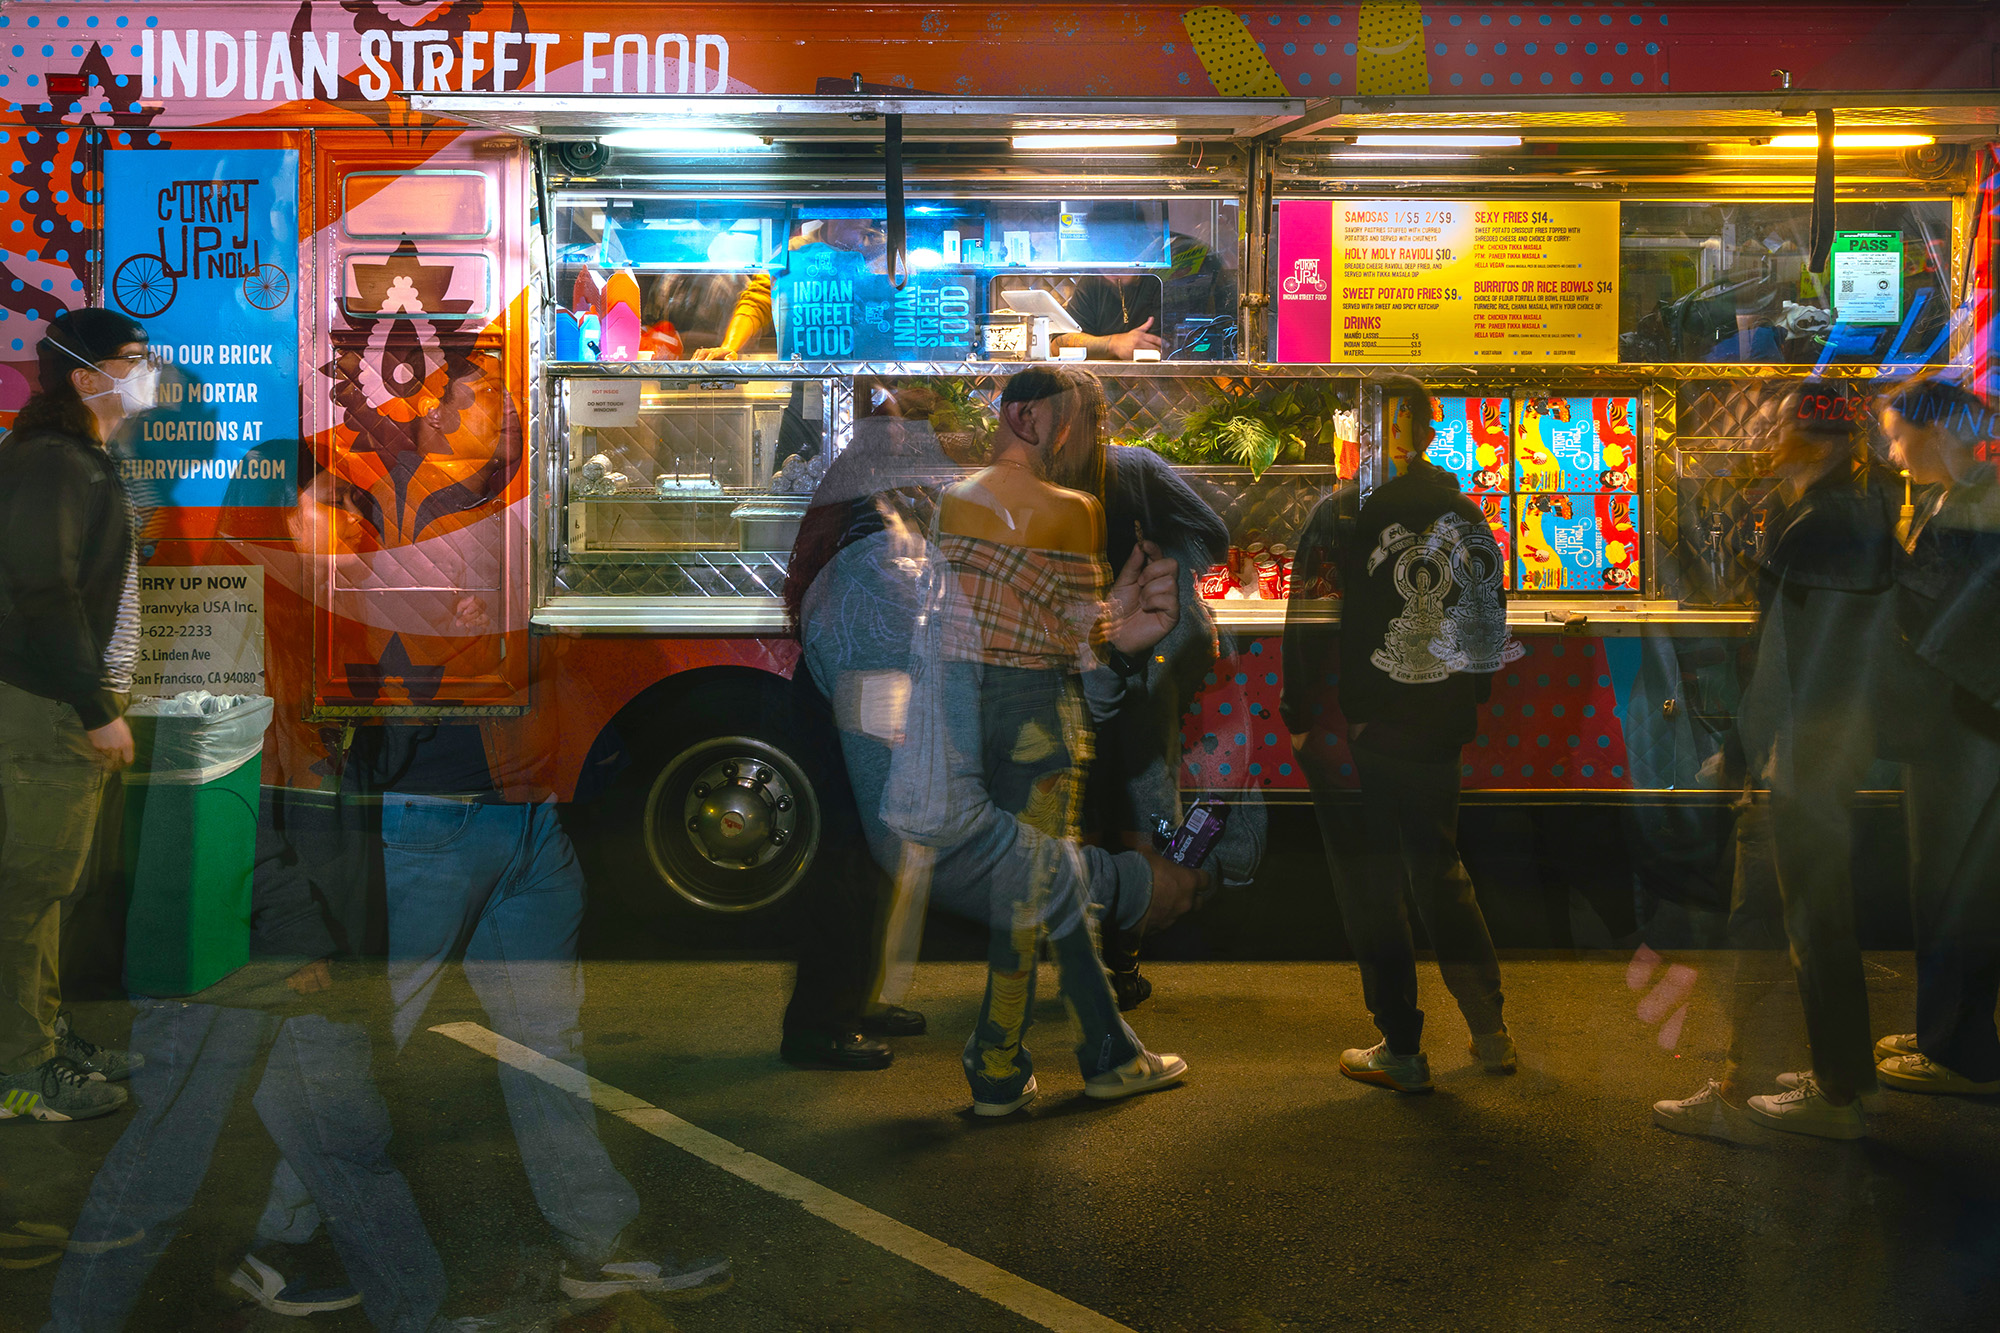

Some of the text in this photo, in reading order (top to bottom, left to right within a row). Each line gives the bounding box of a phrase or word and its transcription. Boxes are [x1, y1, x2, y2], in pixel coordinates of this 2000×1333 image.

[142, 29, 730, 101] INDIAN STREET FOOD
[158, 179, 259, 249] CURRY
[1345, 211, 1388, 223] SAMOSAS
[1395, 211, 1419, 223] 1/$5
[1475, 212, 1548, 224] SEXY FRIES $14
[158, 225, 222, 279] UP
[1345, 248, 1451, 260] HOLY MOLY RAVIOLI $10
[1850, 240, 1888, 251] PASS
[208, 240, 260, 279] NOW
[794, 280, 853, 302] INDIAN
[1343, 288, 1374, 300] SWEET
[1378, 288, 1414, 300] POTATO
[1417, 288, 1442, 300] FRIES
[1474, 281, 1612, 293] BURRITOS OR RICE BOWLS $14
[792, 303, 854, 326] STREET
[894, 286, 916, 347] INDIAN
[916, 286, 939, 348] STREET
[939, 285, 970, 347] FOOD
[1344, 317, 1381, 329] DRINKS
[793, 326, 854, 356] FOOD
[179, 344, 273, 365] OUR BRICK
[188, 383, 258, 403] MORTAR
[144, 421, 263, 441] LOCATIONS AT
[1552, 428, 1573, 457] CURRY
[120, 459, 286, 480] CURRYUPNOW.COM
[1554, 526, 1575, 554] CURRY
[180, 576, 247, 590] UP NOW
[203, 601, 257, 613] USA Inc.
[142, 649, 210, 661] S. Linden Ave
[132, 672, 256, 685] San Francisco, CA 94080
